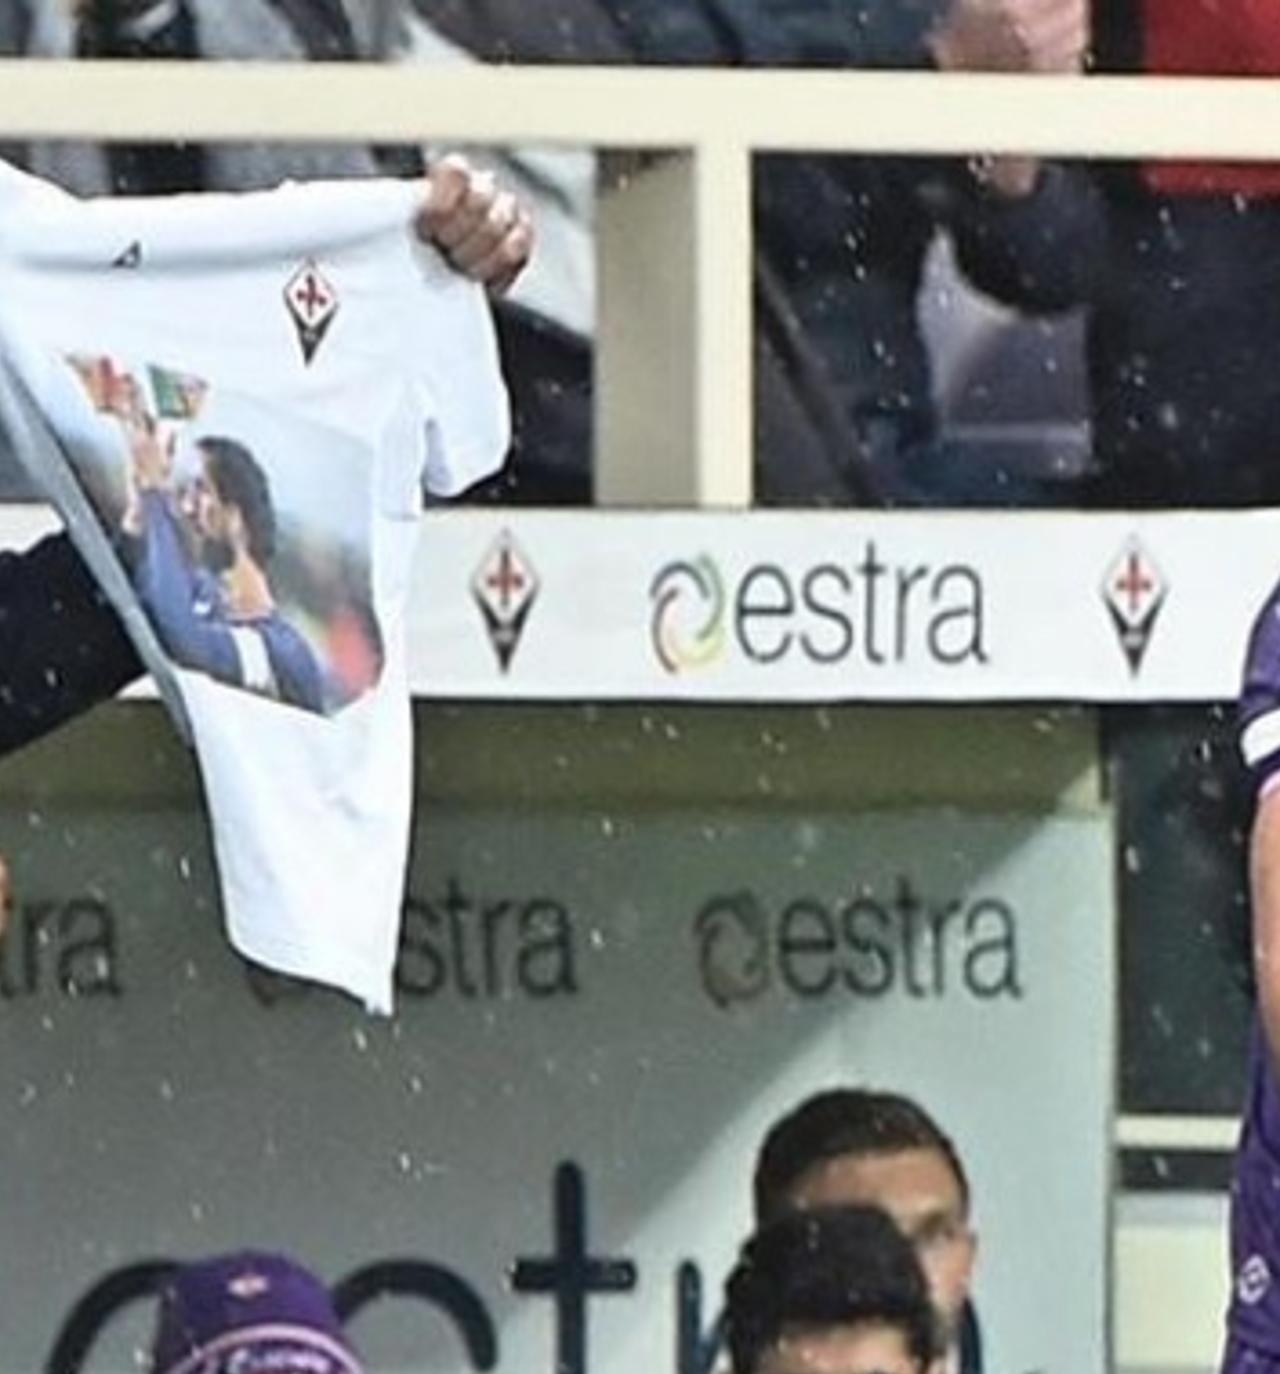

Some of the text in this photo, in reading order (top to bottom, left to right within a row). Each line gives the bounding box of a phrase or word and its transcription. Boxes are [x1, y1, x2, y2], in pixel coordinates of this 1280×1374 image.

[735, 540, 989, 664] estra
[394, 874, 578, 999] stra
[776, 874, 1024, 999] estra
